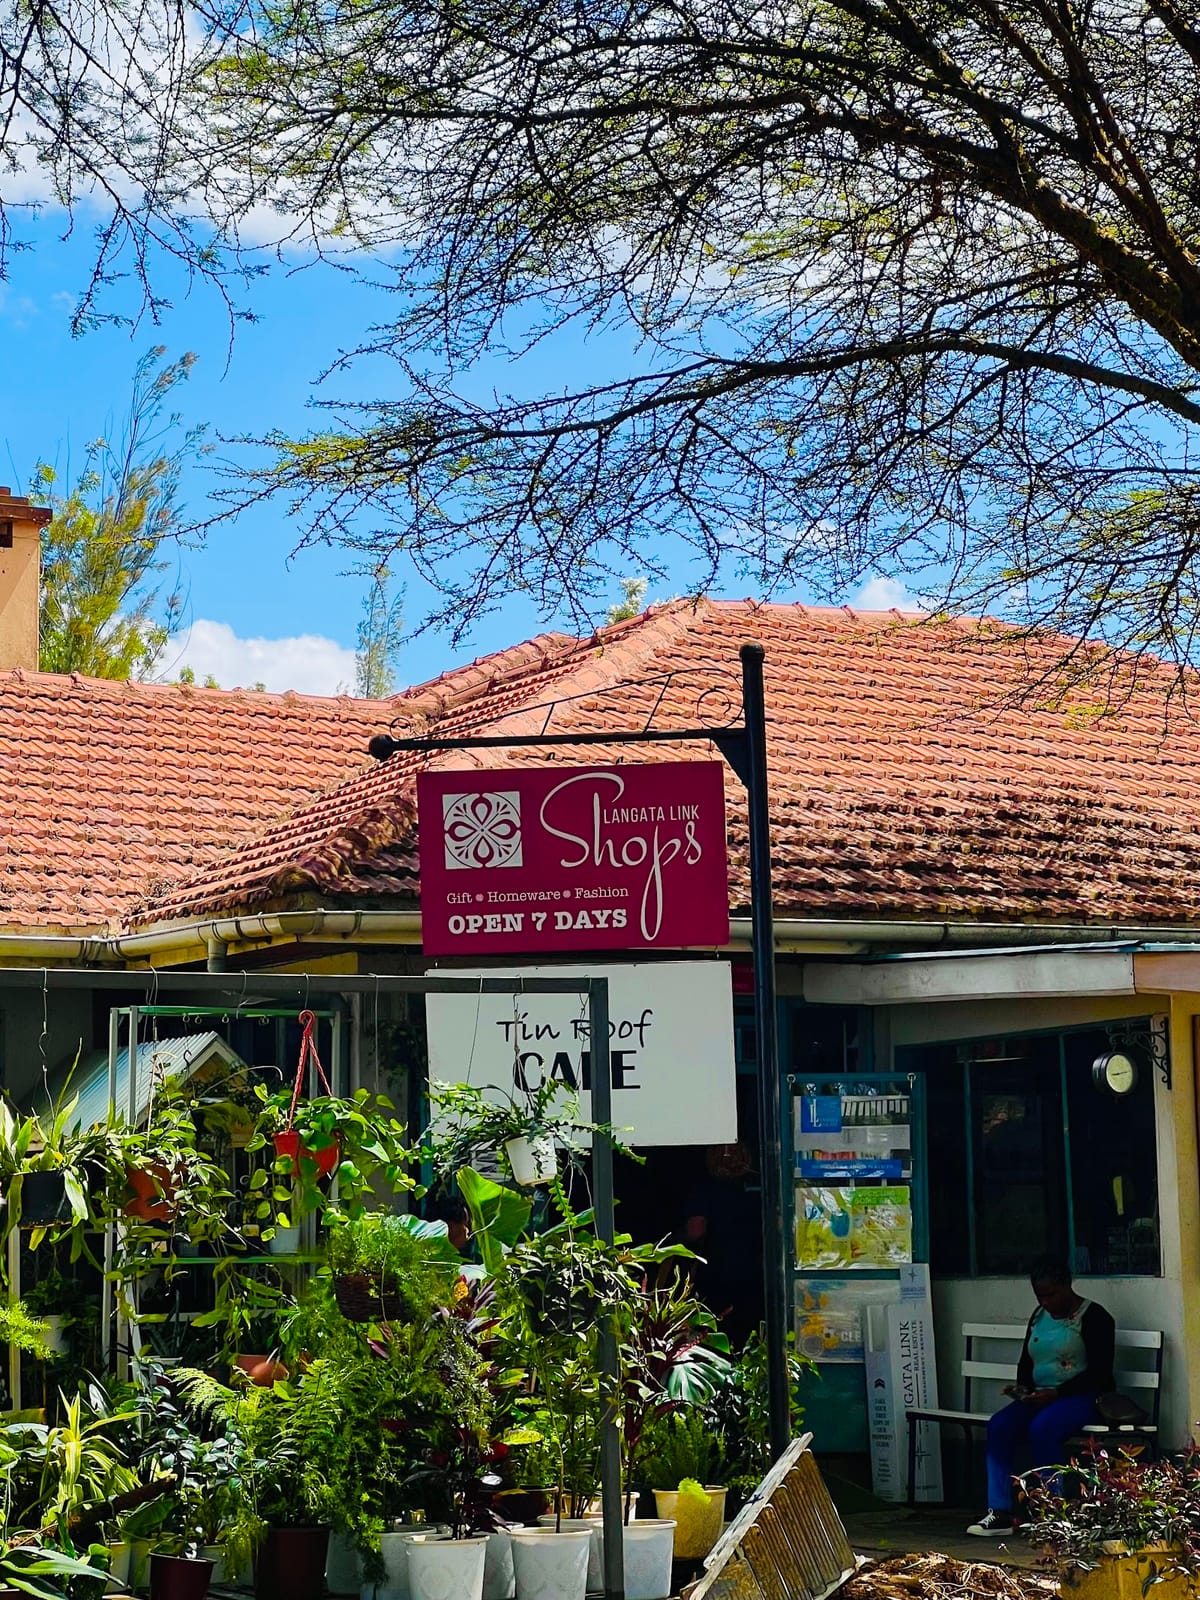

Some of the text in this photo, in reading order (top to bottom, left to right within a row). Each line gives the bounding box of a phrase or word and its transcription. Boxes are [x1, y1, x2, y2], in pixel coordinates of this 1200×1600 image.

[603, 804, 699, 825] LANGATA LINK
[540, 772, 702, 941] Shops
[447, 886, 630, 905] Gift Homeware Fashion
[448, 909, 628, 935] OPEN 7 DAYS
[496, 1012, 560, 1043] Tin
[900, 1320, 911, 1358] LINK
